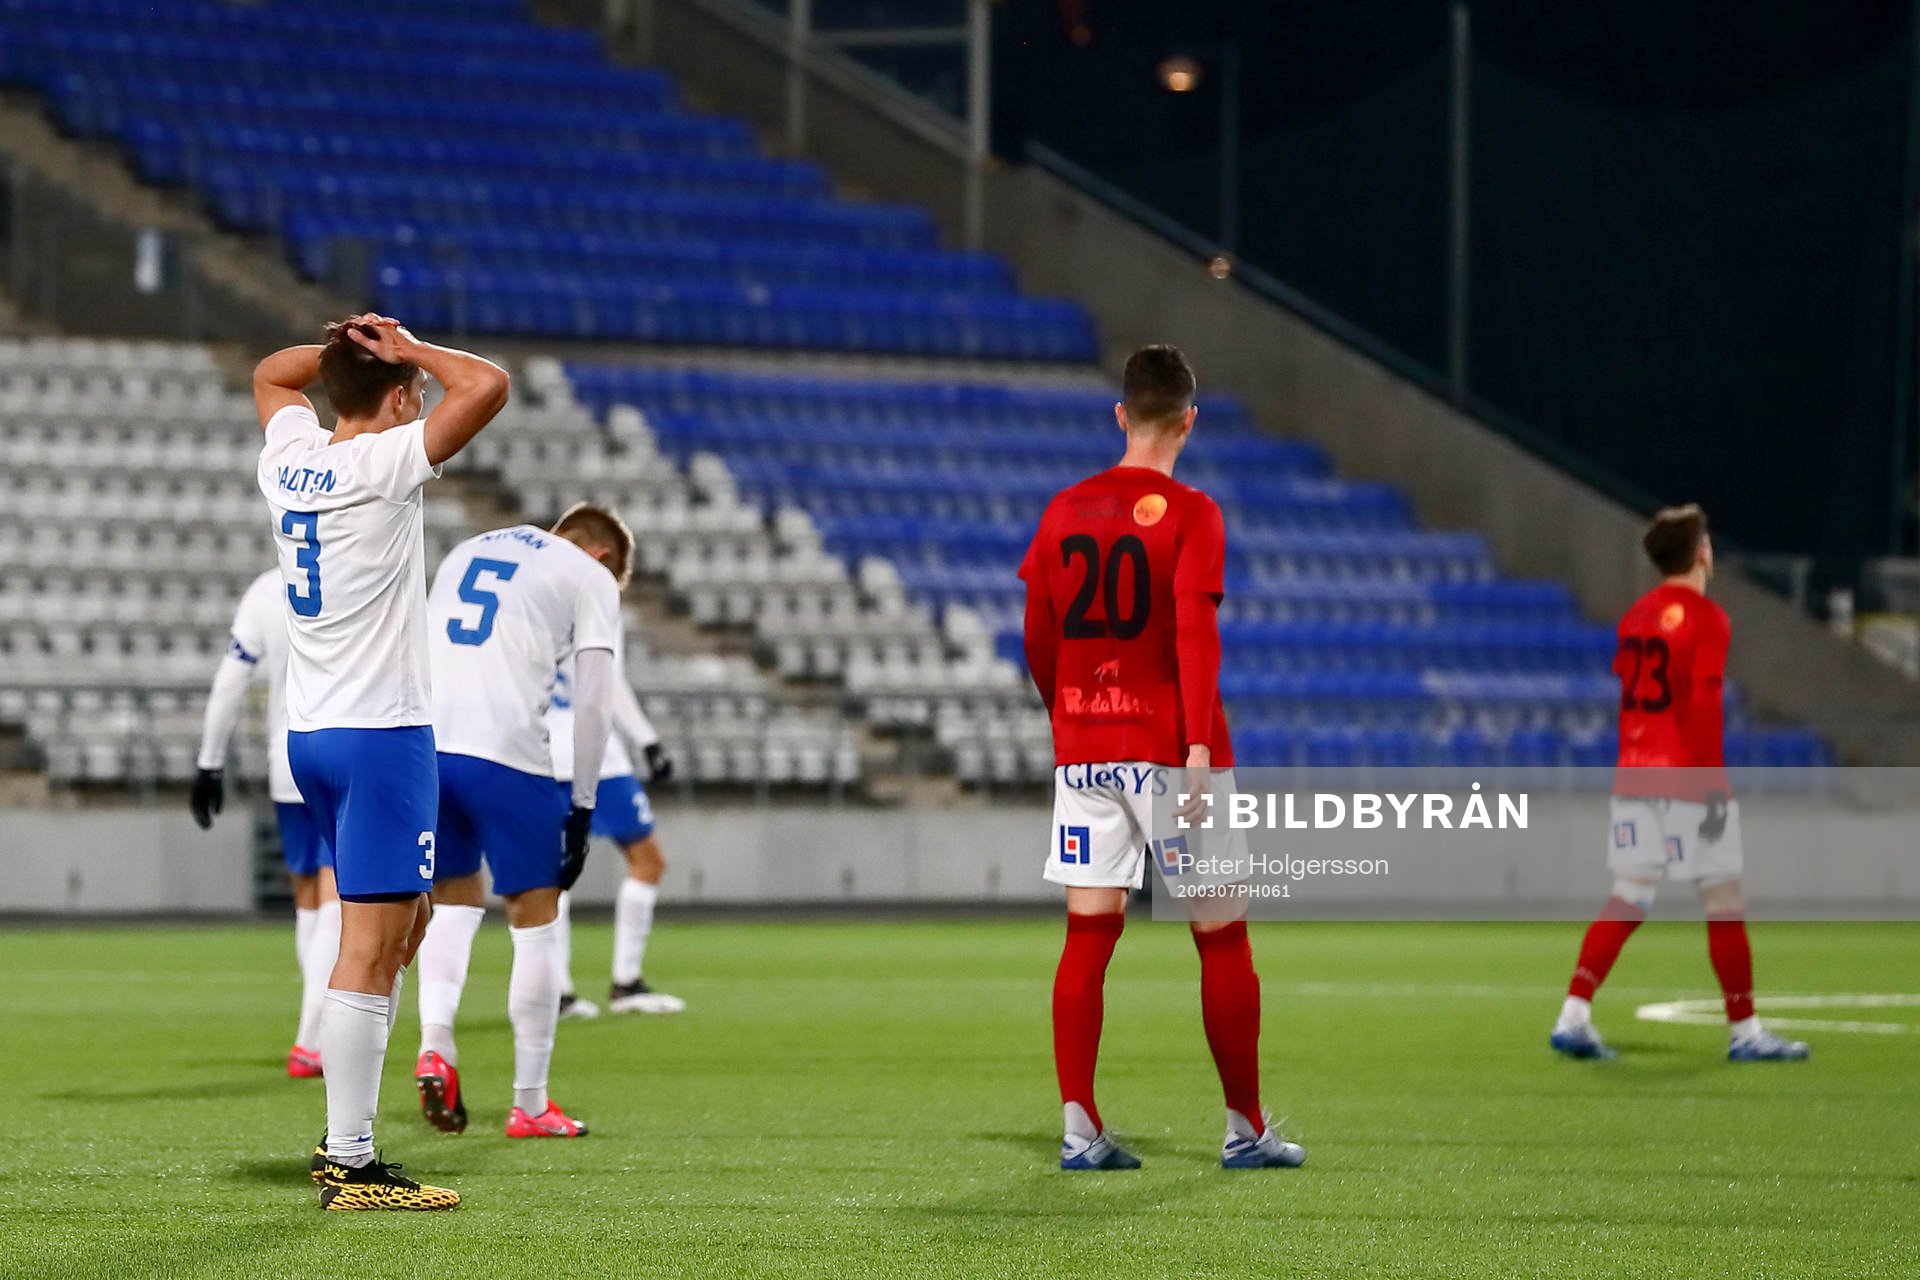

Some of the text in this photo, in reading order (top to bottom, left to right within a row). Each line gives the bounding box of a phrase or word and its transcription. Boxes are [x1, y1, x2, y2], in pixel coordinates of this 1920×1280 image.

[281, 510, 322, 617] 3
[446, 557, 519, 646] 5
[1061, 533, 1151, 641] 20
[1621, 636, 1673, 713] 23
[418, 831, 435, 880] 3
